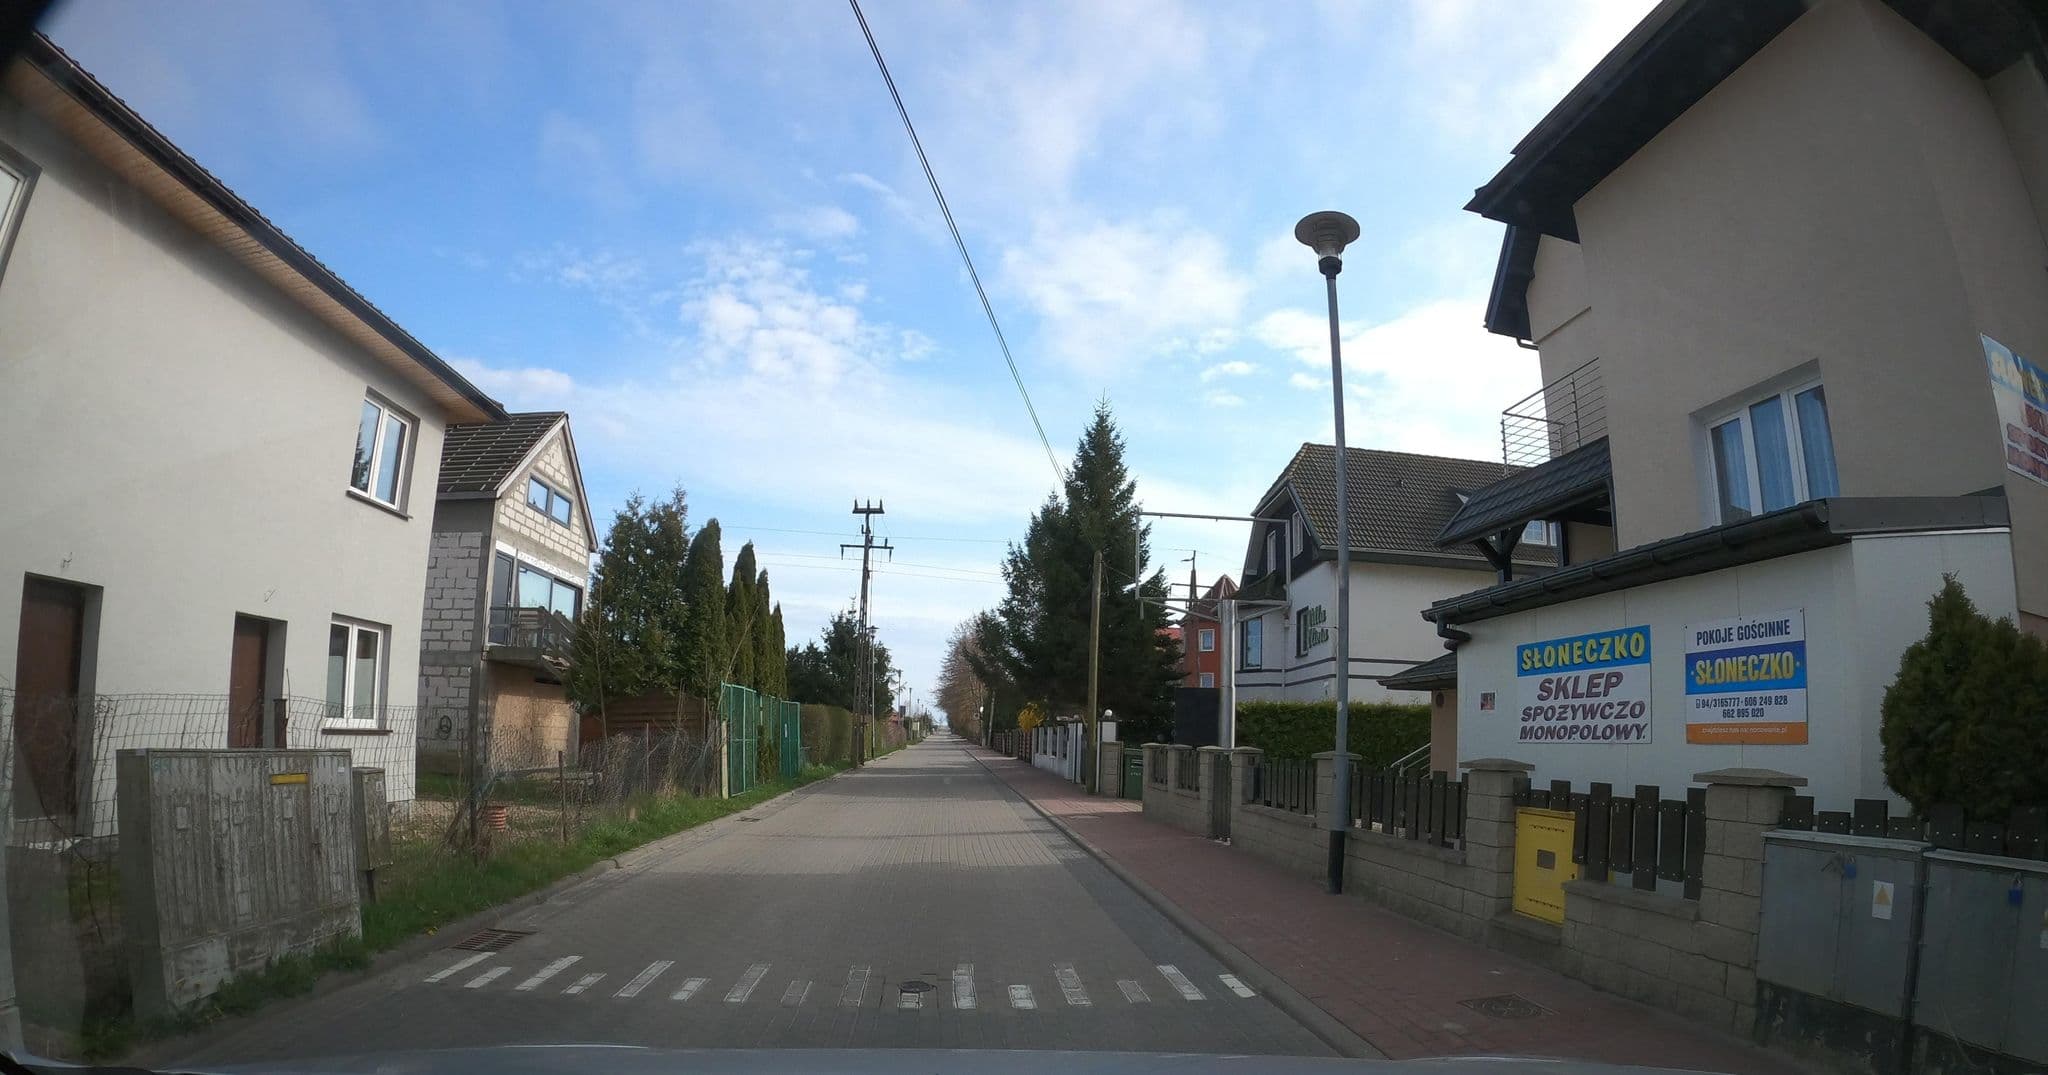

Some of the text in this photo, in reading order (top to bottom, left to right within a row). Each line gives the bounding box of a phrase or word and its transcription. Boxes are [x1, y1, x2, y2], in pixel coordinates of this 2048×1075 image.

[1696, 619, 1791, 646] POKOJE GOŚCINNE
[1522, 632, 1645, 671] SŁONECZKO
[1695, 651, 1795, 685] SŁONECZKO
[1537, 671, 1624, 701] SKLEP
[1759, 696, 1773, 706] 249
